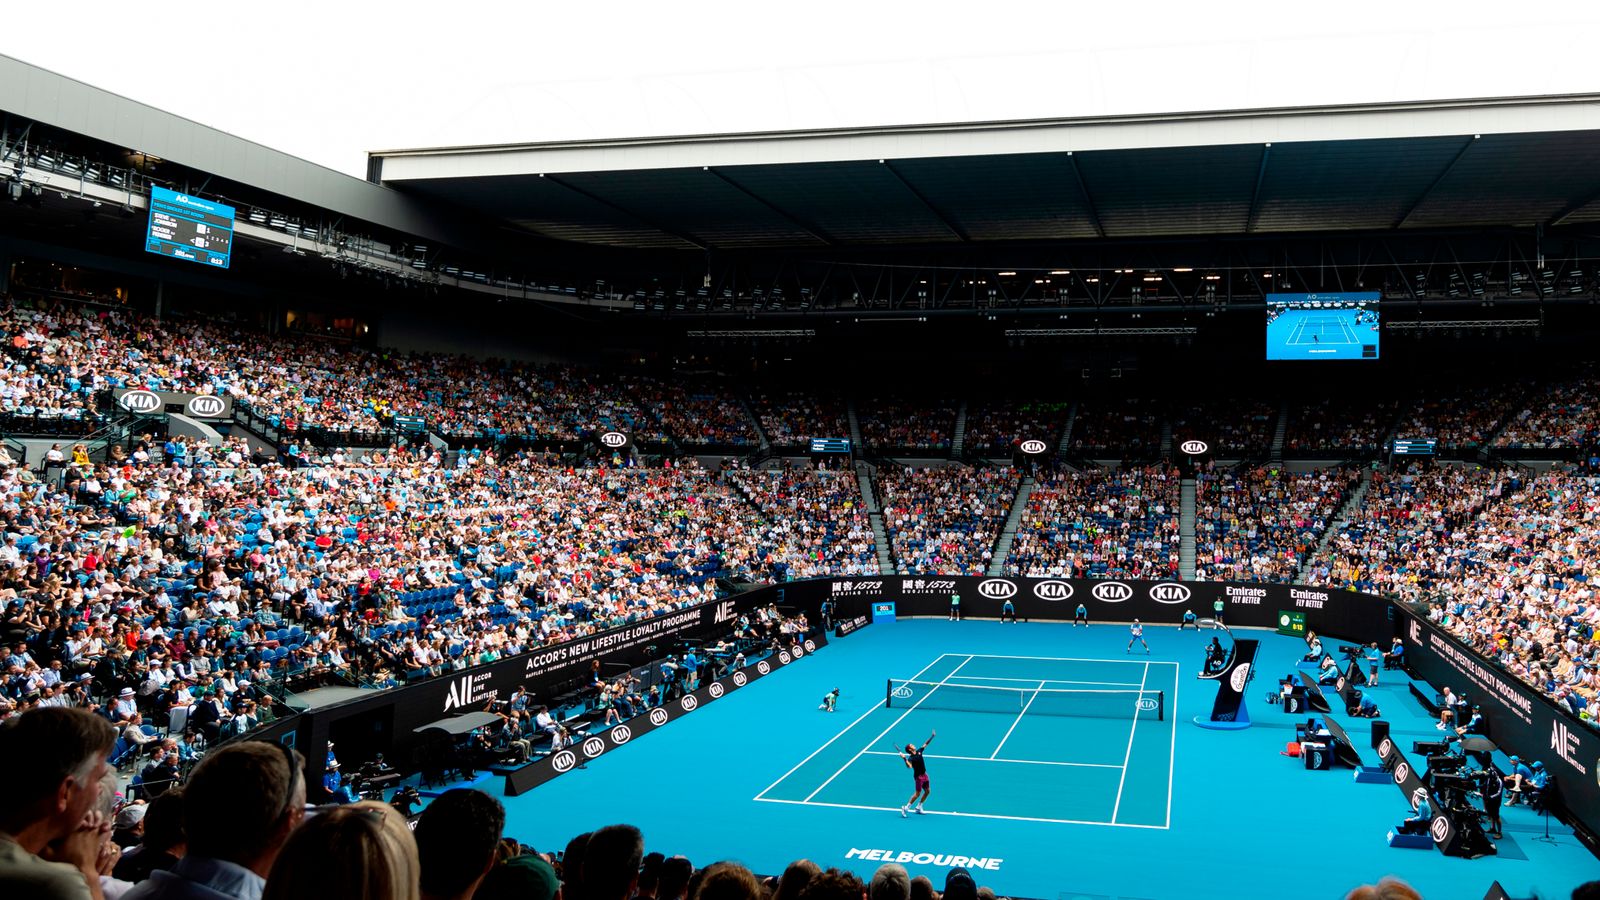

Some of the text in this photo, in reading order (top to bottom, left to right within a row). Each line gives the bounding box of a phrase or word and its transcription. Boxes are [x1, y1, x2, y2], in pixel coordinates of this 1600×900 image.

[127, 395, 154, 408] KIA
[194, 400, 219, 412] KIA
[985, 584, 1011, 595] KIA
[1040, 585, 1066, 596] KIA
[1099, 586, 1126, 598] KIA
[1156, 587, 1184, 599] KIA
[1226, 587, 1266, 597] Emirates
[1290, 589, 1328, 601] Emirates
[1305, 600, 1323, 609] BETTER
[526, 610, 701, 670] ACCOR'S NEW LIFESTYLE LOYALTY PROGRAMME
[474, 672, 492, 682] ACCOR
[473, 684, 485, 692] LIVE
[1475, 665, 1495, 687] LOYALTY
[1496, 679, 1531, 714] PROGRAMME
[472, 689, 498, 702] LIMITLESS
[683, 697, 695, 708] KIA
[652, 711, 666, 723] KIA
[613, 728, 628, 741] KIA
[586, 741, 602, 755] KIA
[555, 754, 572, 769] KIA
[845, 848, 1003, 870] MELBOURNE
